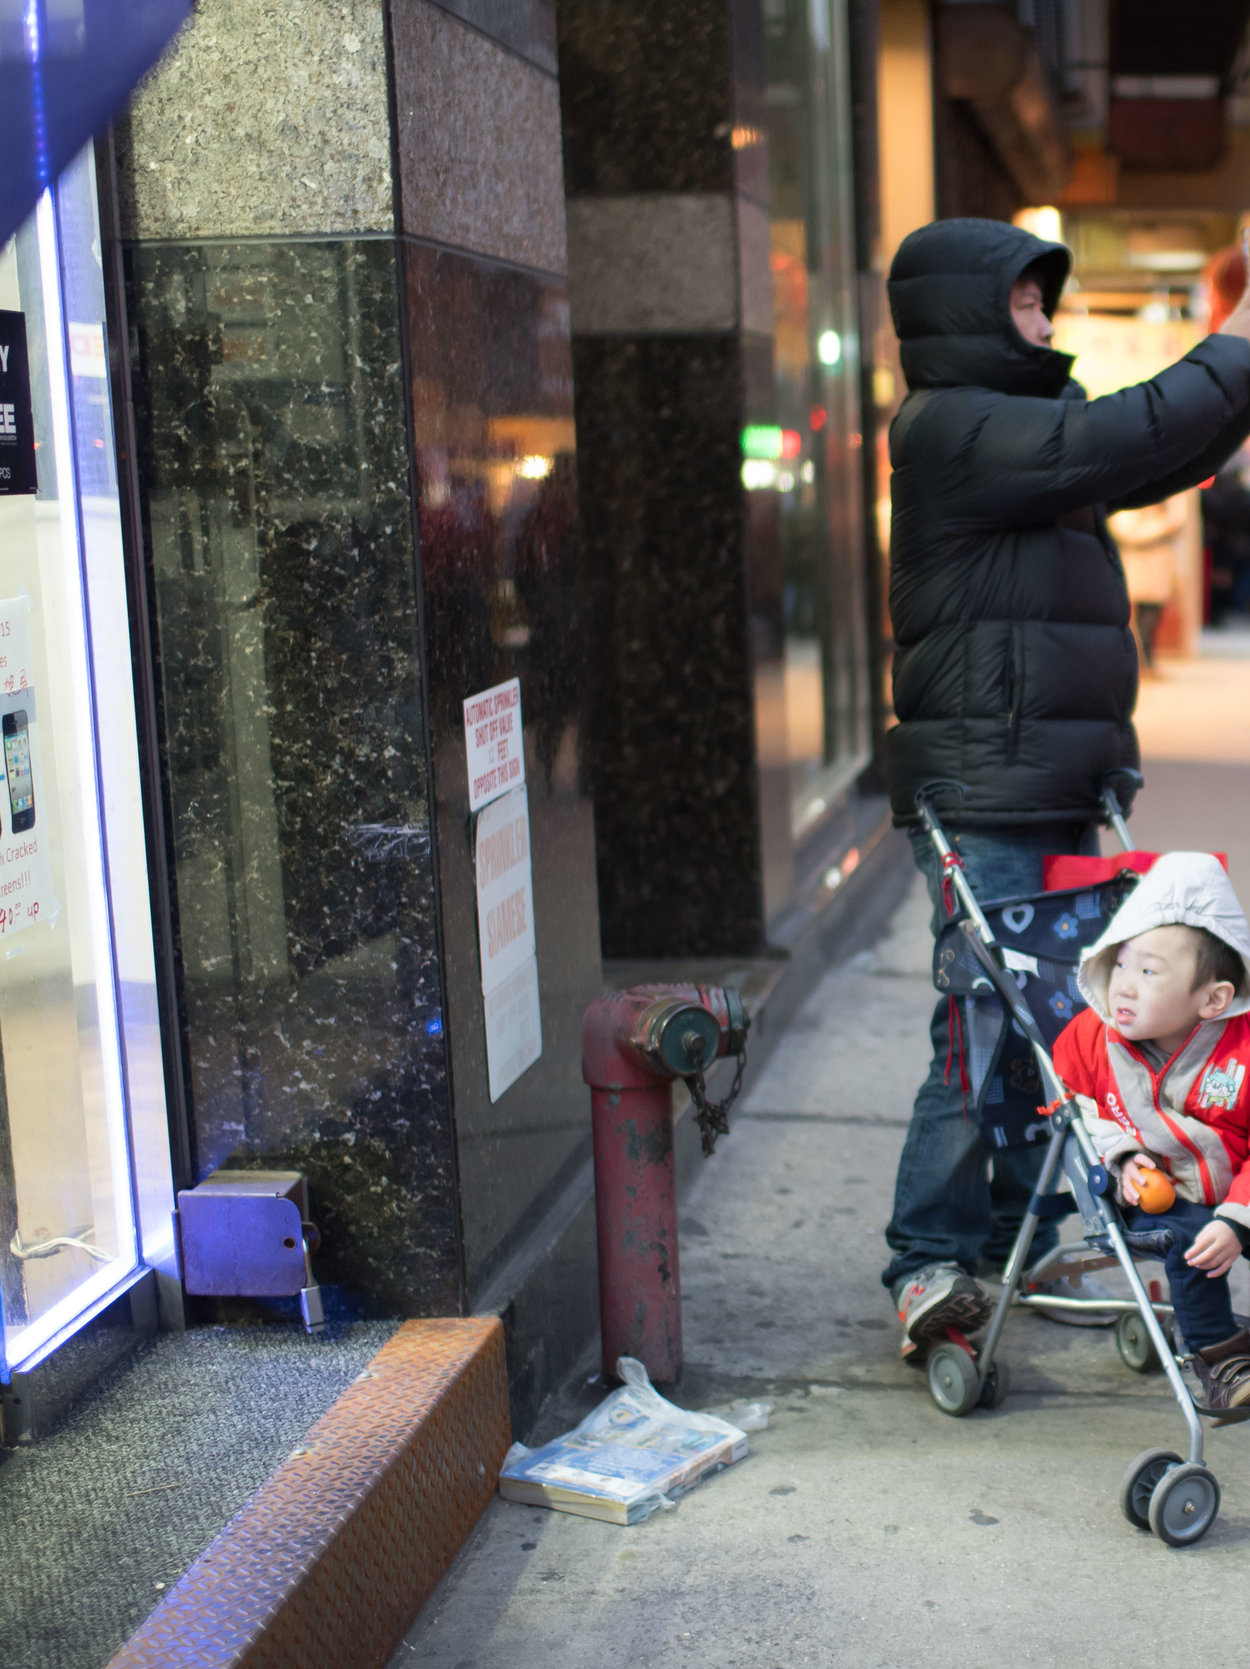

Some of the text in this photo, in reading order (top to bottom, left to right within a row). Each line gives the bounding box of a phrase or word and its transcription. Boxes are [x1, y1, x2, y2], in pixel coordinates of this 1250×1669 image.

[0, 345, 9, 373] Y
[466, 685, 519, 727] AUTOMATIC SPRINKLER
[475, 712, 513, 749] SHUT OFF VALVE
[497, 738, 509, 761] FEET
[473, 756, 520, 800] OPPOSITE THIS SIGN
[6, 836, 38, 863] Cracked
[479, 815, 528, 891] SPRINKLER
[0, 870, 31, 898] reens!!!
[486, 885, 527, 960] SIAMESE
